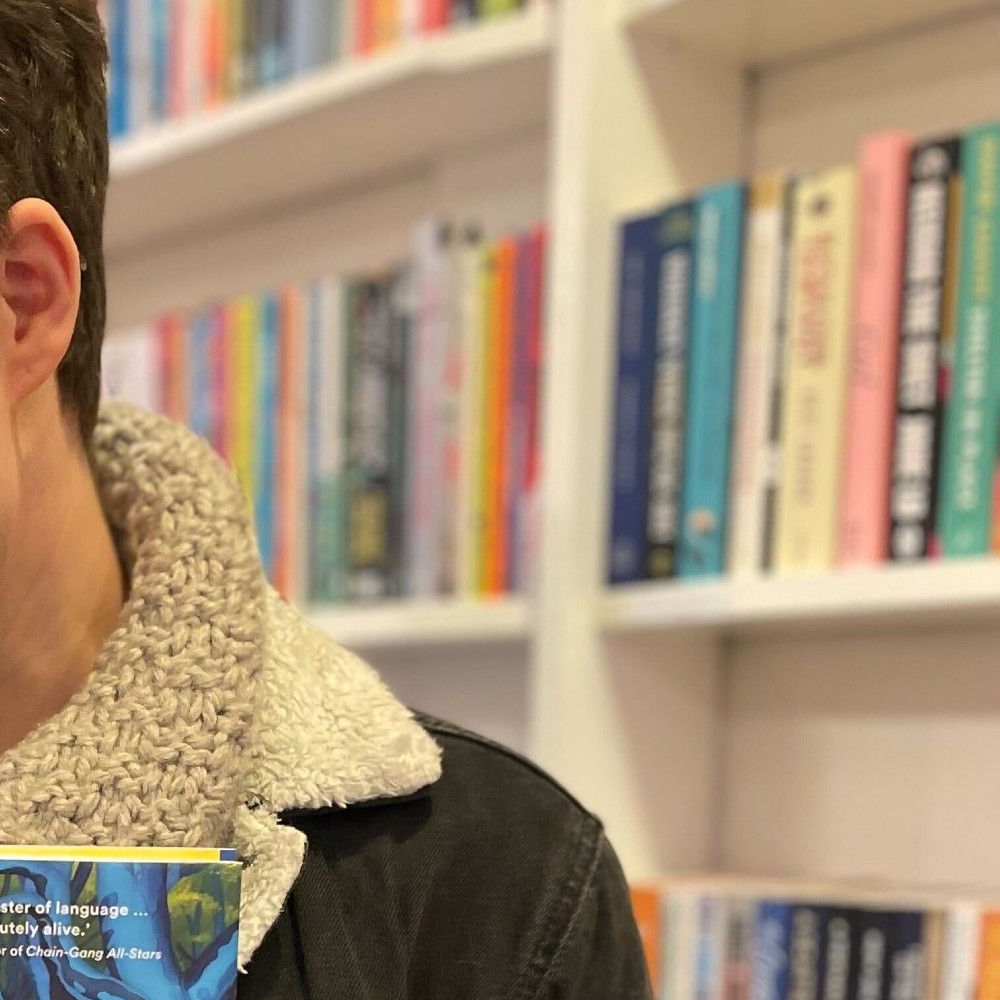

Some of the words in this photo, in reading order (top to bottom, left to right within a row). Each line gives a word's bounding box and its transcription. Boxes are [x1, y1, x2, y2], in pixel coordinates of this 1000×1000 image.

[35, 901, 52, 914] of
[56, 902, 129, 919] language
[10, 945, 24, 957] of
[26, 945, 104, 961] Chain-Gang
[106, 947, 162, 960] All-Stars
